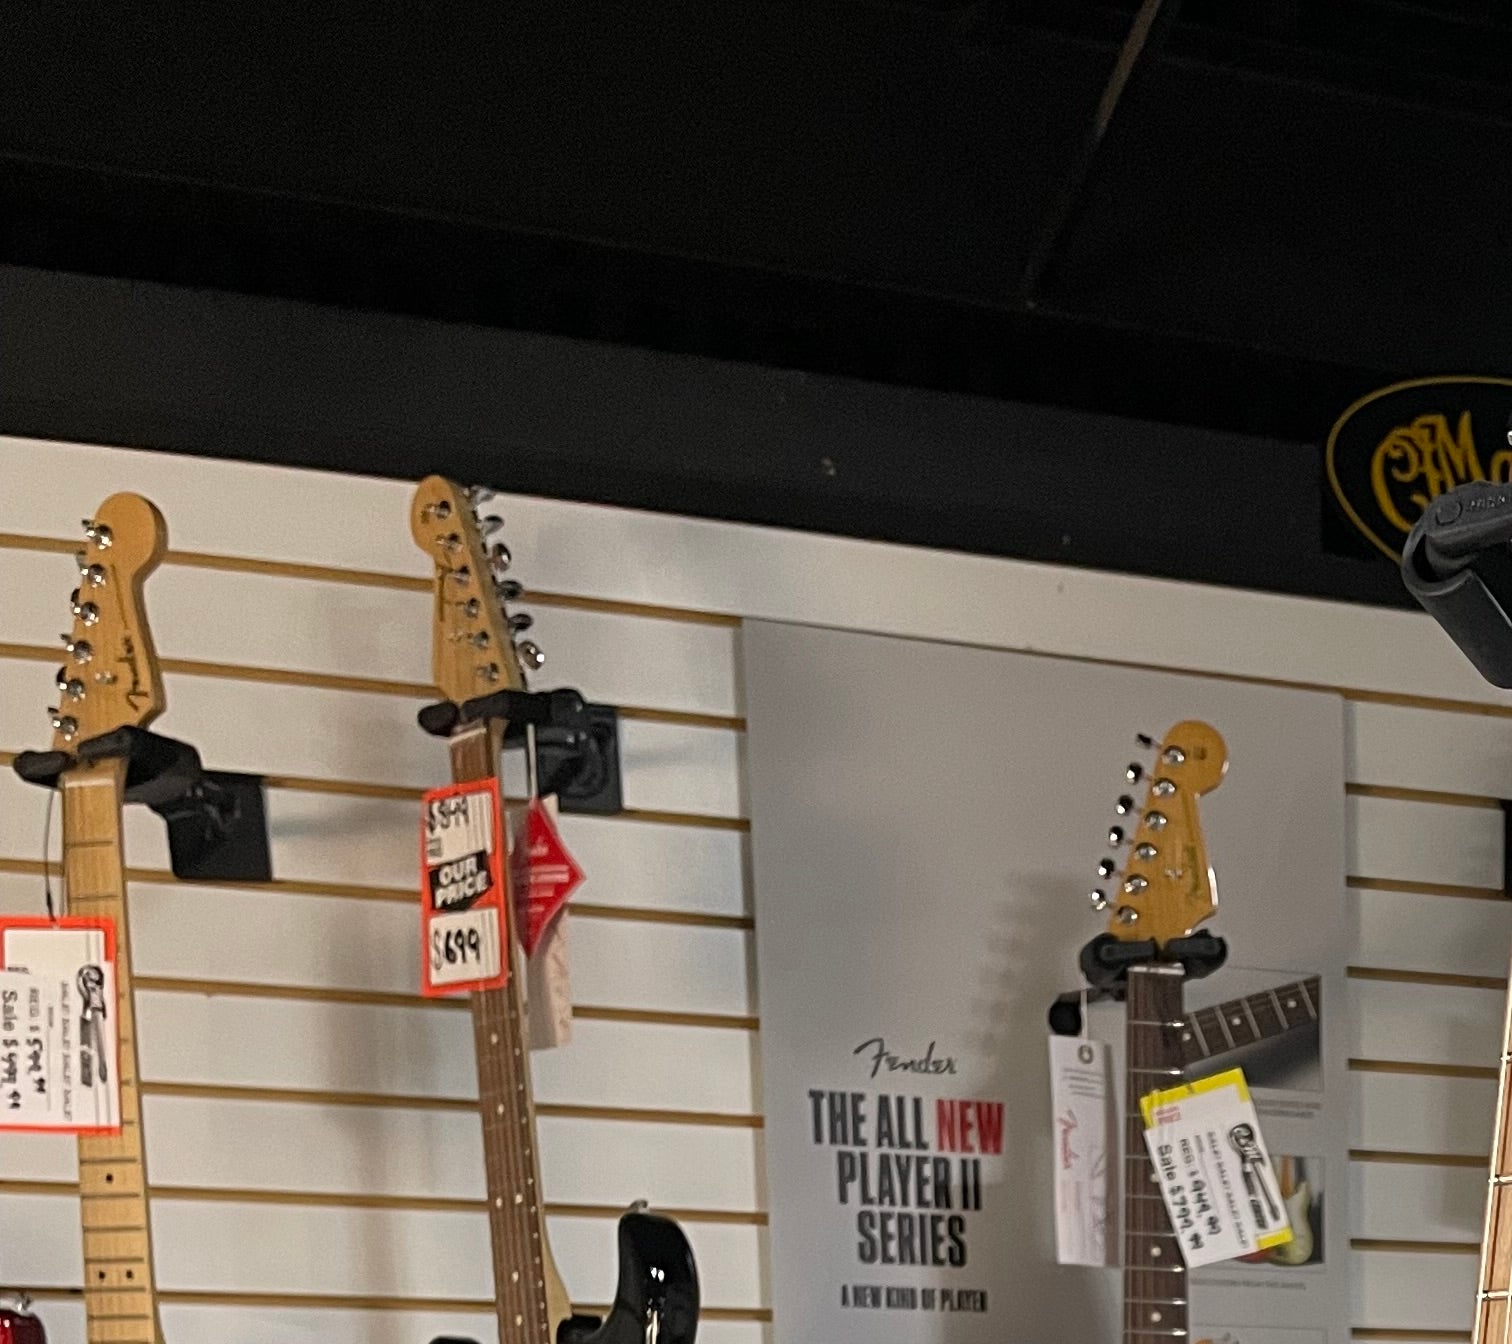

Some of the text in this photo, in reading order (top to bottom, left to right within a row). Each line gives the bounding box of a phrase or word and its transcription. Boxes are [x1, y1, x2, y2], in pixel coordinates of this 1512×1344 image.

[434, 870, 489, 910] PRICE
[438, 855, 478, 887] OUR
[432, 927, 481, 971] $699
[2, 989, 19, 1032] Sale
[853, 1037, 957, 1079] Fender
[808, 1088, 1005, 1155] THE ALL NEW
[837, 1150, 982, 1211] PLAYER II
[1156, 1143, 1180, 1181] Sale
[857, 1210, 967, 1268] SERIES
[841, 1284, 849, 1307] A
[852, 1285, 881, 1309] NEW
[921, 1288, 936, 1311] OF
[940, 1288, 988, 1312] PLAYER
